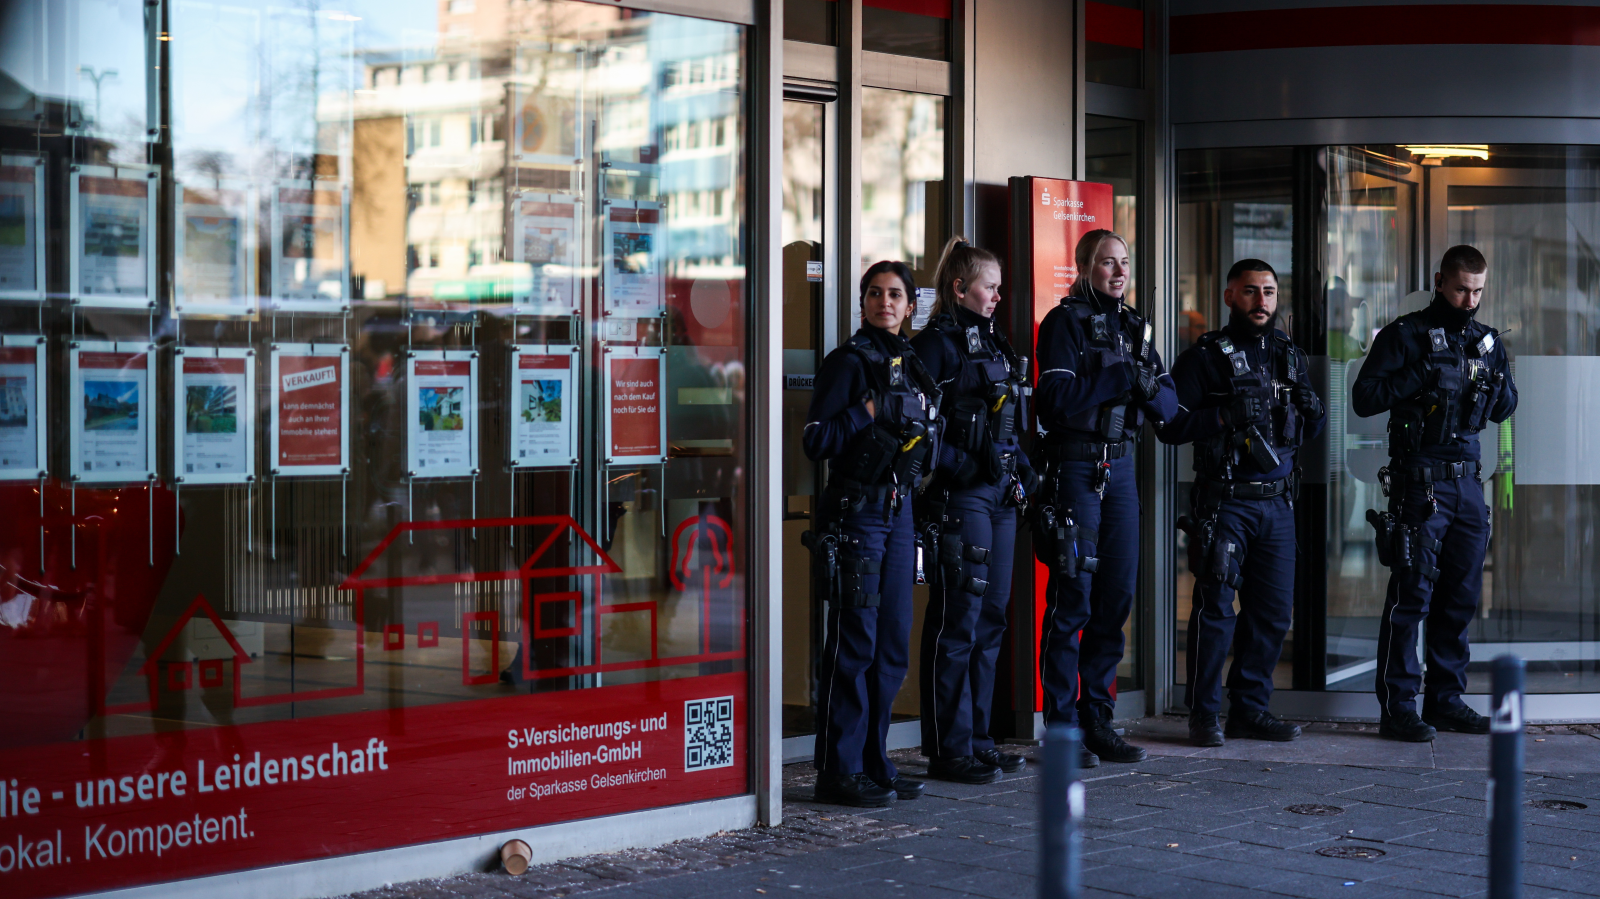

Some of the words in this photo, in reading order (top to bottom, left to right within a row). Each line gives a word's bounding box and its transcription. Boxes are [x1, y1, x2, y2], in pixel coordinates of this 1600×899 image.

[1053, 197, 1084, 209] Sparkasse
[1053, 211, 1096, 223] Gelsenkirchen
[284, 369, 335, 387] VERKAUFT!
[615, 380, 626, 388] Wir
[627, 380, 639, 388] sind
[640, 380, 653, 388] auch
[788, 376, 814, 387] DRÜCKE
[642, 392, 656, 400] Kauf
[283, 402, 299, 410] kann
[300, 402, 335, 410] demnächst
[288, 415, 304, 423] auch
[314, 415, 330, 423] Ihrer
[281, 428, 313, 436] Immobilie
[314, 428, 338, 436] stehen!
[507, 719, 637, 749] S-Versicherungs-
[640, 712, 668, 733] und
[507, 741, 642, 776] Immobilien-GmbH
[75, 770, 188, 808] unsere
[198, 738, 389, 793] Leidenschaft
[506, 785, 526, 801] der
[529, 778, 588, 800] Sparkasse
[590, 767, 667, 789] Gelsenkirchen
[85, 807, 255, 857] Kompetent.
